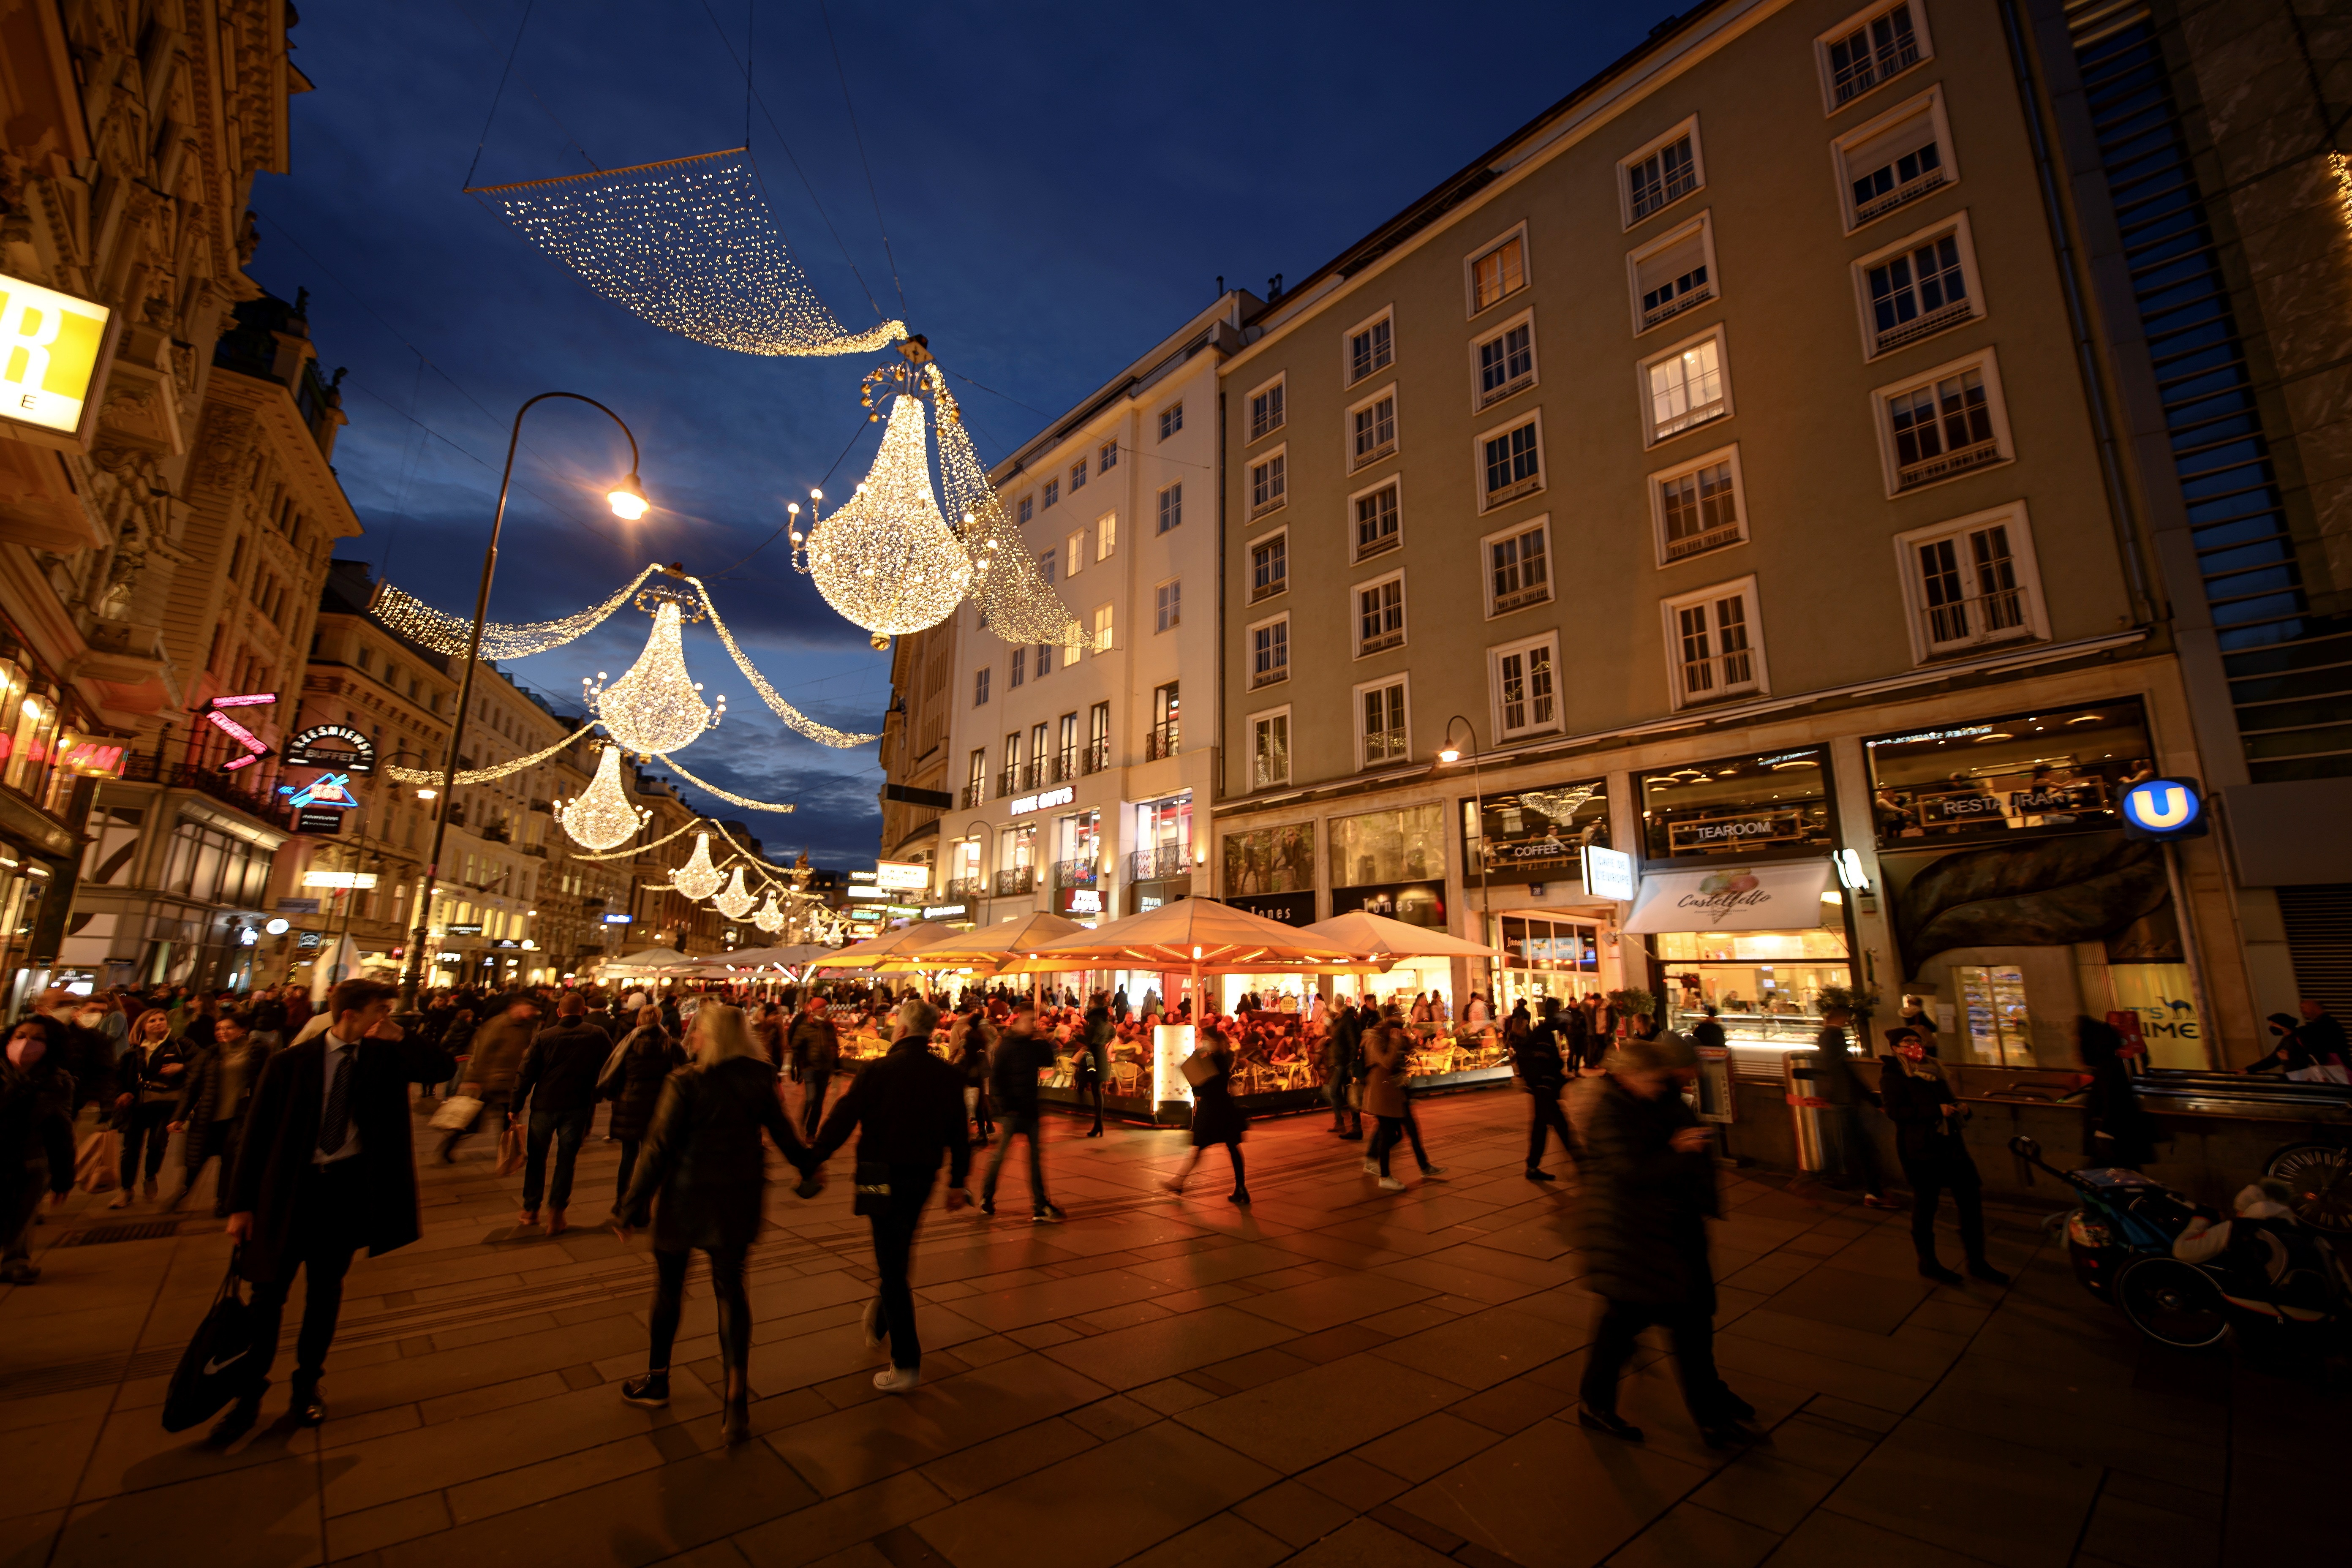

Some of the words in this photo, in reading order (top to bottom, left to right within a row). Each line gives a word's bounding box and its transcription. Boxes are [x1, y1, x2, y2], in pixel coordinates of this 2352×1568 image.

[304, 749, 358, 762] BUFFET
[1011, 795, 1038, 815] FIVE
[1038, 786, 1073, 809] GUYS
[1943, 789, 2077, 815] RESTAURANT
[2132, 787, 2189, 828] U
[1696, 821, 1772, 838] TEAROOM
[1514, 844, 1559, 857] COFFEE
[1075, 889, 1100, 901] FIVE
[1677, 889, 1772, 908] Castelletto
[1363, 898, 1413, 914] Jones
[2140, 1022, 2200, 1039] IME
